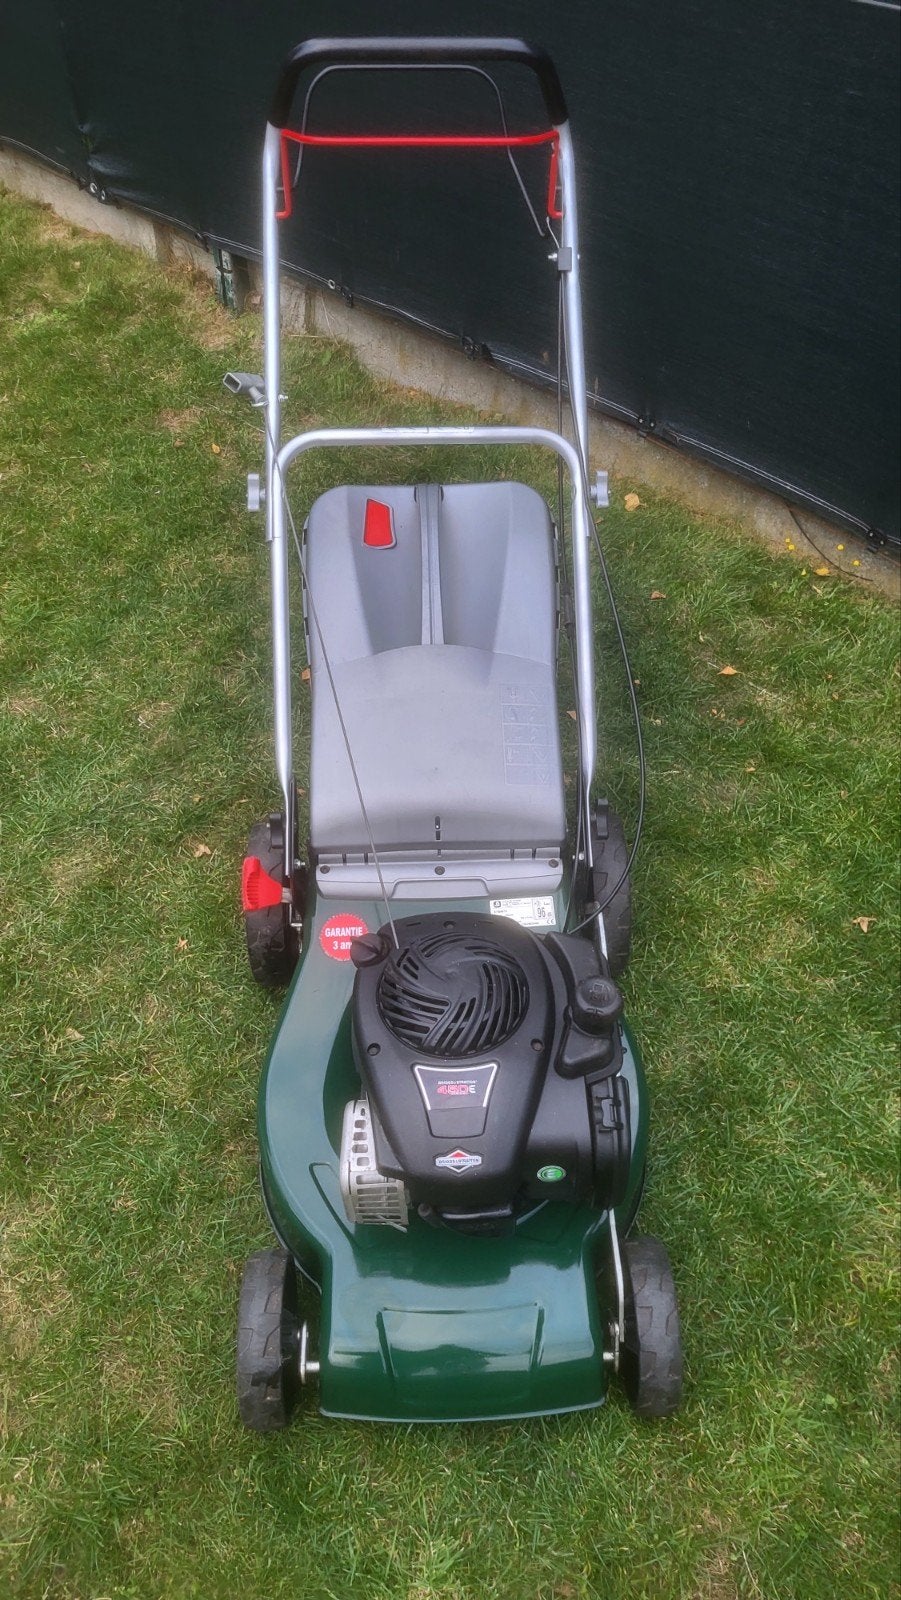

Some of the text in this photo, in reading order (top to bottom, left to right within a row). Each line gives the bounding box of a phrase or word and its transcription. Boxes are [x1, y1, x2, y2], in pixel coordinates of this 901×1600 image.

[537, 907, 546, 918] 96
[325, 926, 363, 937] GARANTIE
[332, 940, 353, 950] 3 an
